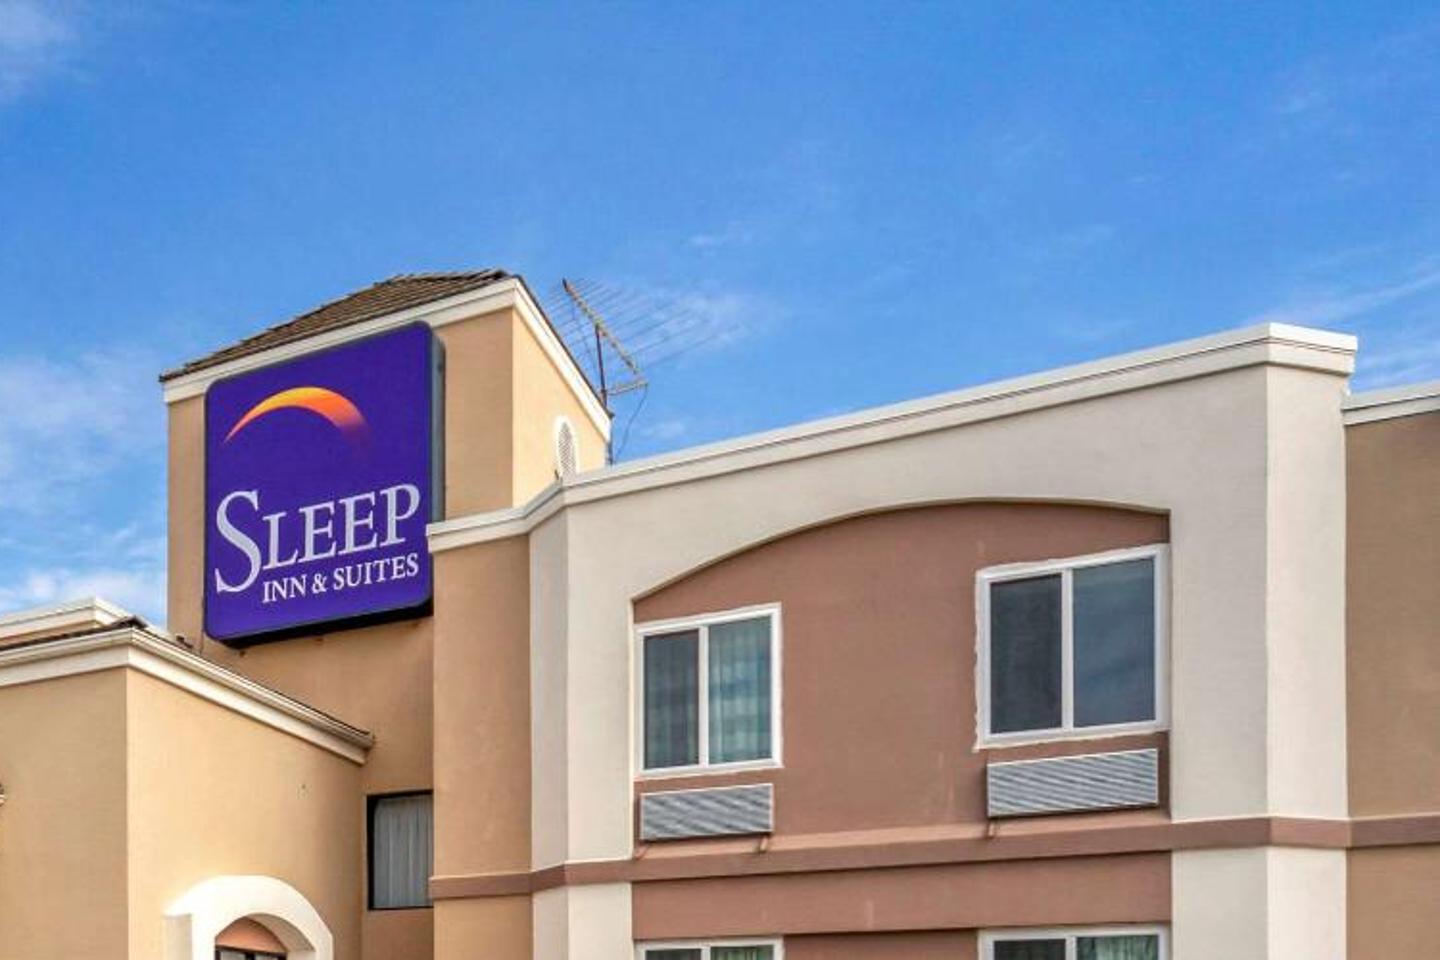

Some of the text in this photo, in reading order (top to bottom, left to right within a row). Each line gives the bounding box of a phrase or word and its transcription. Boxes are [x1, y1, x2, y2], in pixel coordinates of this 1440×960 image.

[214, 484, 421, 593] SLEEP
[262, 552, 419, 603] INN & SUITES
